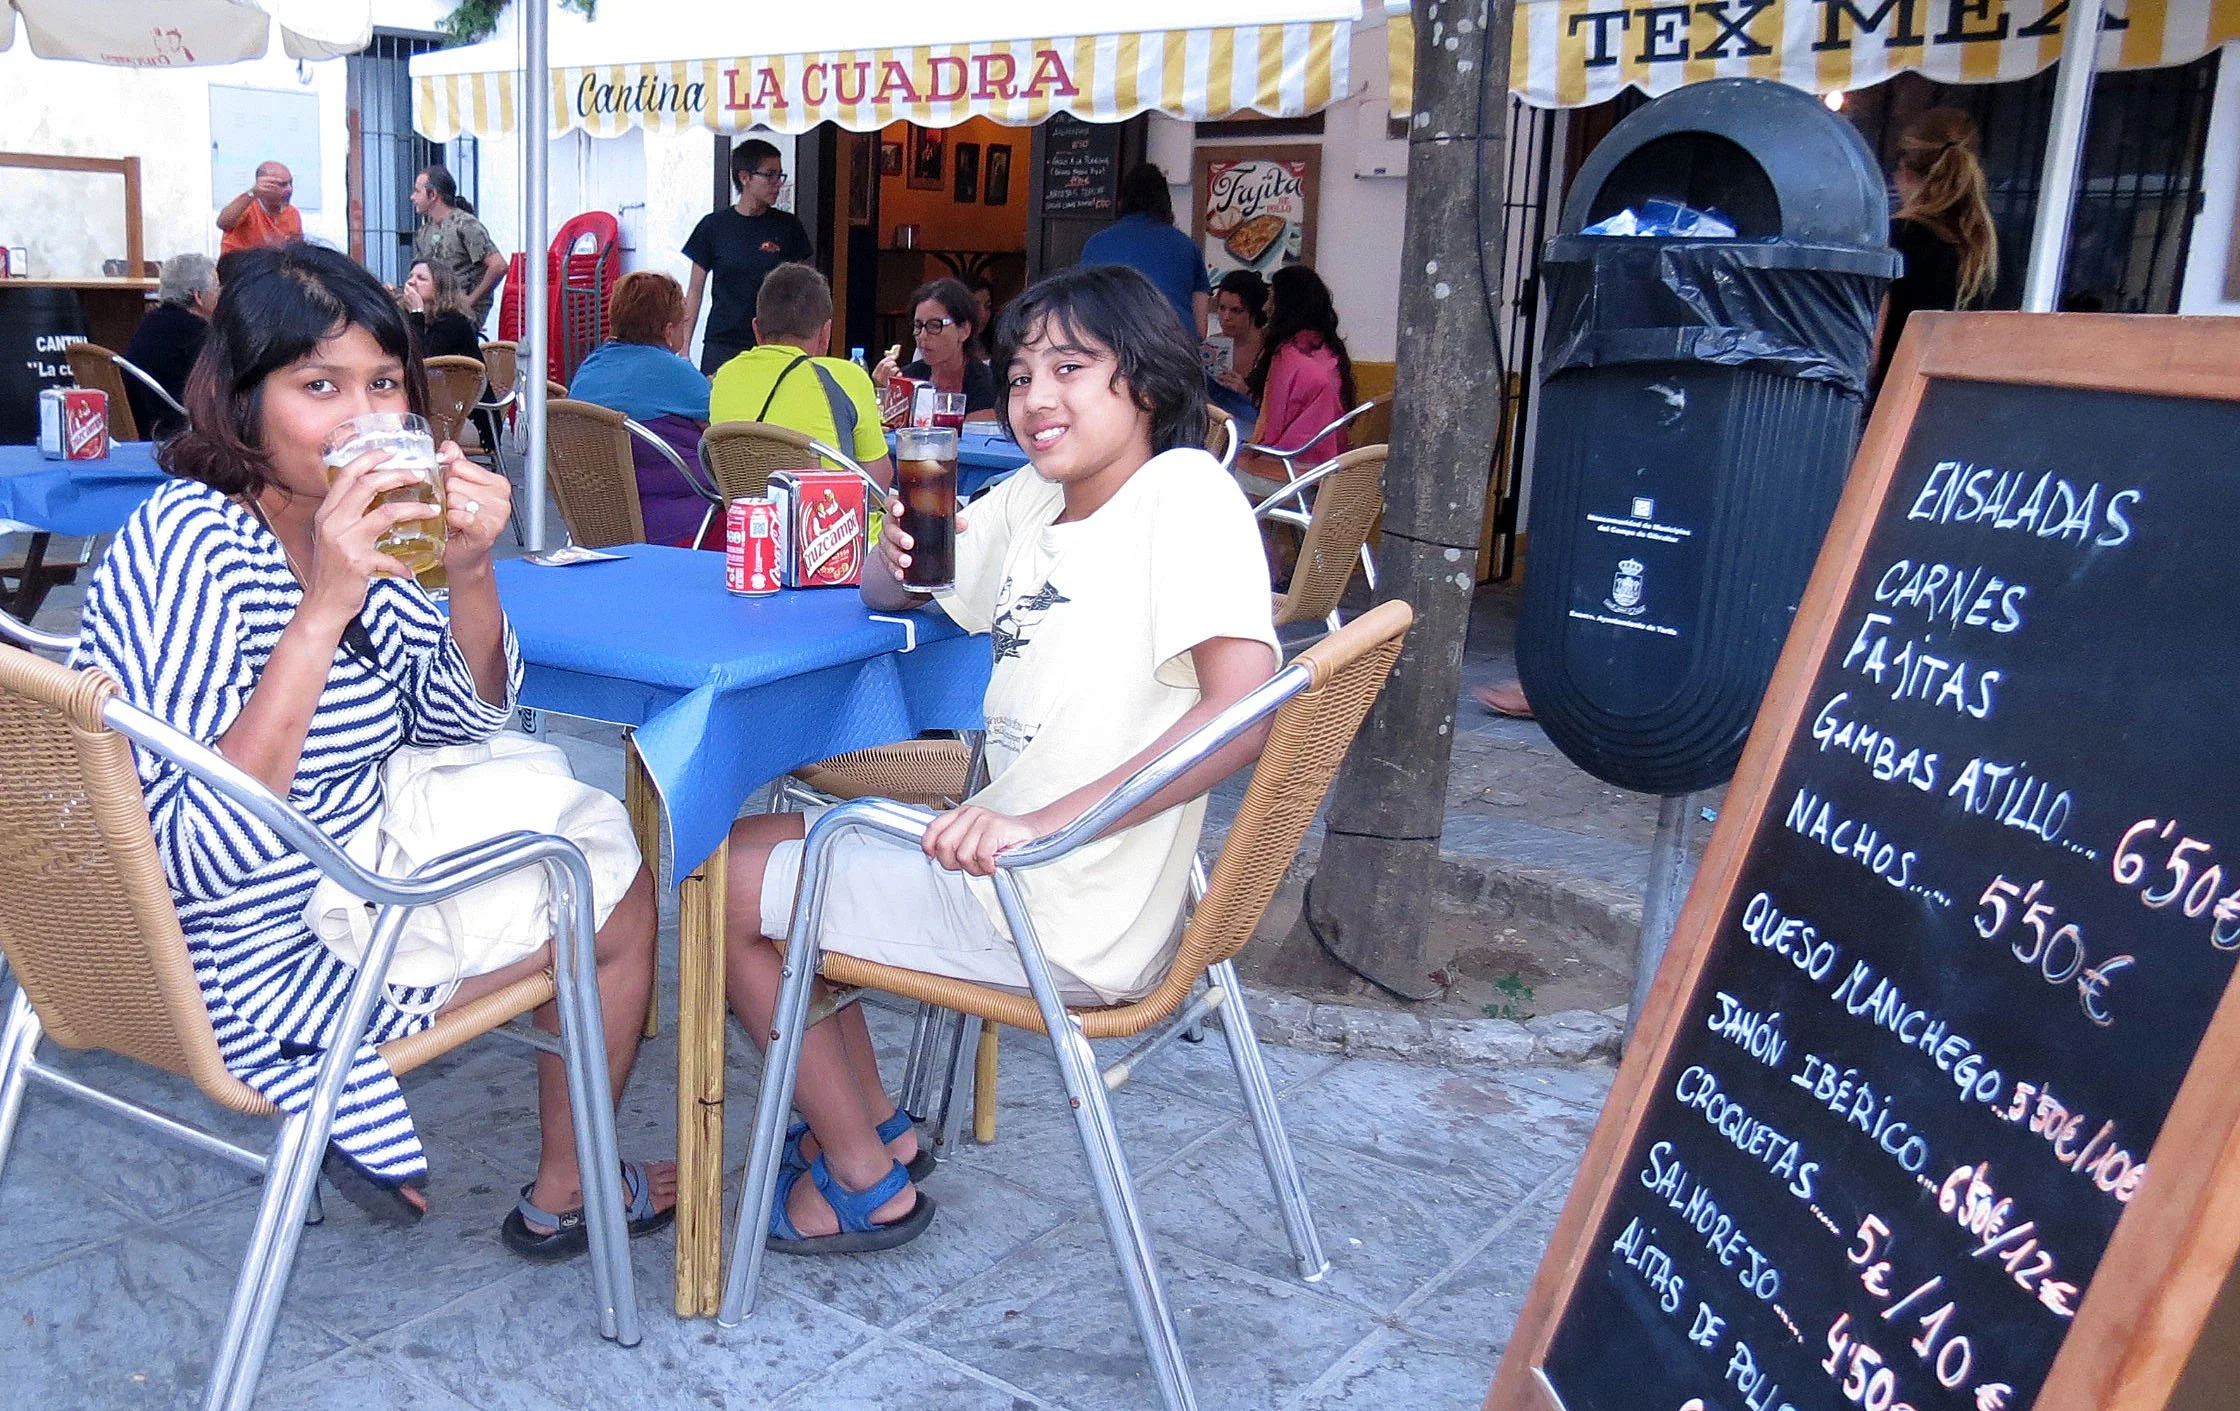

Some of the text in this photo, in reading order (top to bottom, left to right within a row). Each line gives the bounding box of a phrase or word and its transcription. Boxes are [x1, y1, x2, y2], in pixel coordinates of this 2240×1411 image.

[1567, 0, 2130, 68] TEX ME
[577, 50, 1080, 118] Cantina LA CUADRA
[1212, 165, 1304, 217] Fajita
[1907, 461, 2141, 546] ENSALADAS
[1875, 560, 2027, 633] CARNES
[1813, 693, 1937, 791] GAMBAS
[1742, 892, 1836, 980] QUESO
[1974, 874, 2136, 1027] 5'50€
[1708, 991, 1787, 1067] JAMÓN
[1612, 1216, 1797, 1411] ALITAS DE POLL
[1822, 1312, 1917, 1411] 4'50
